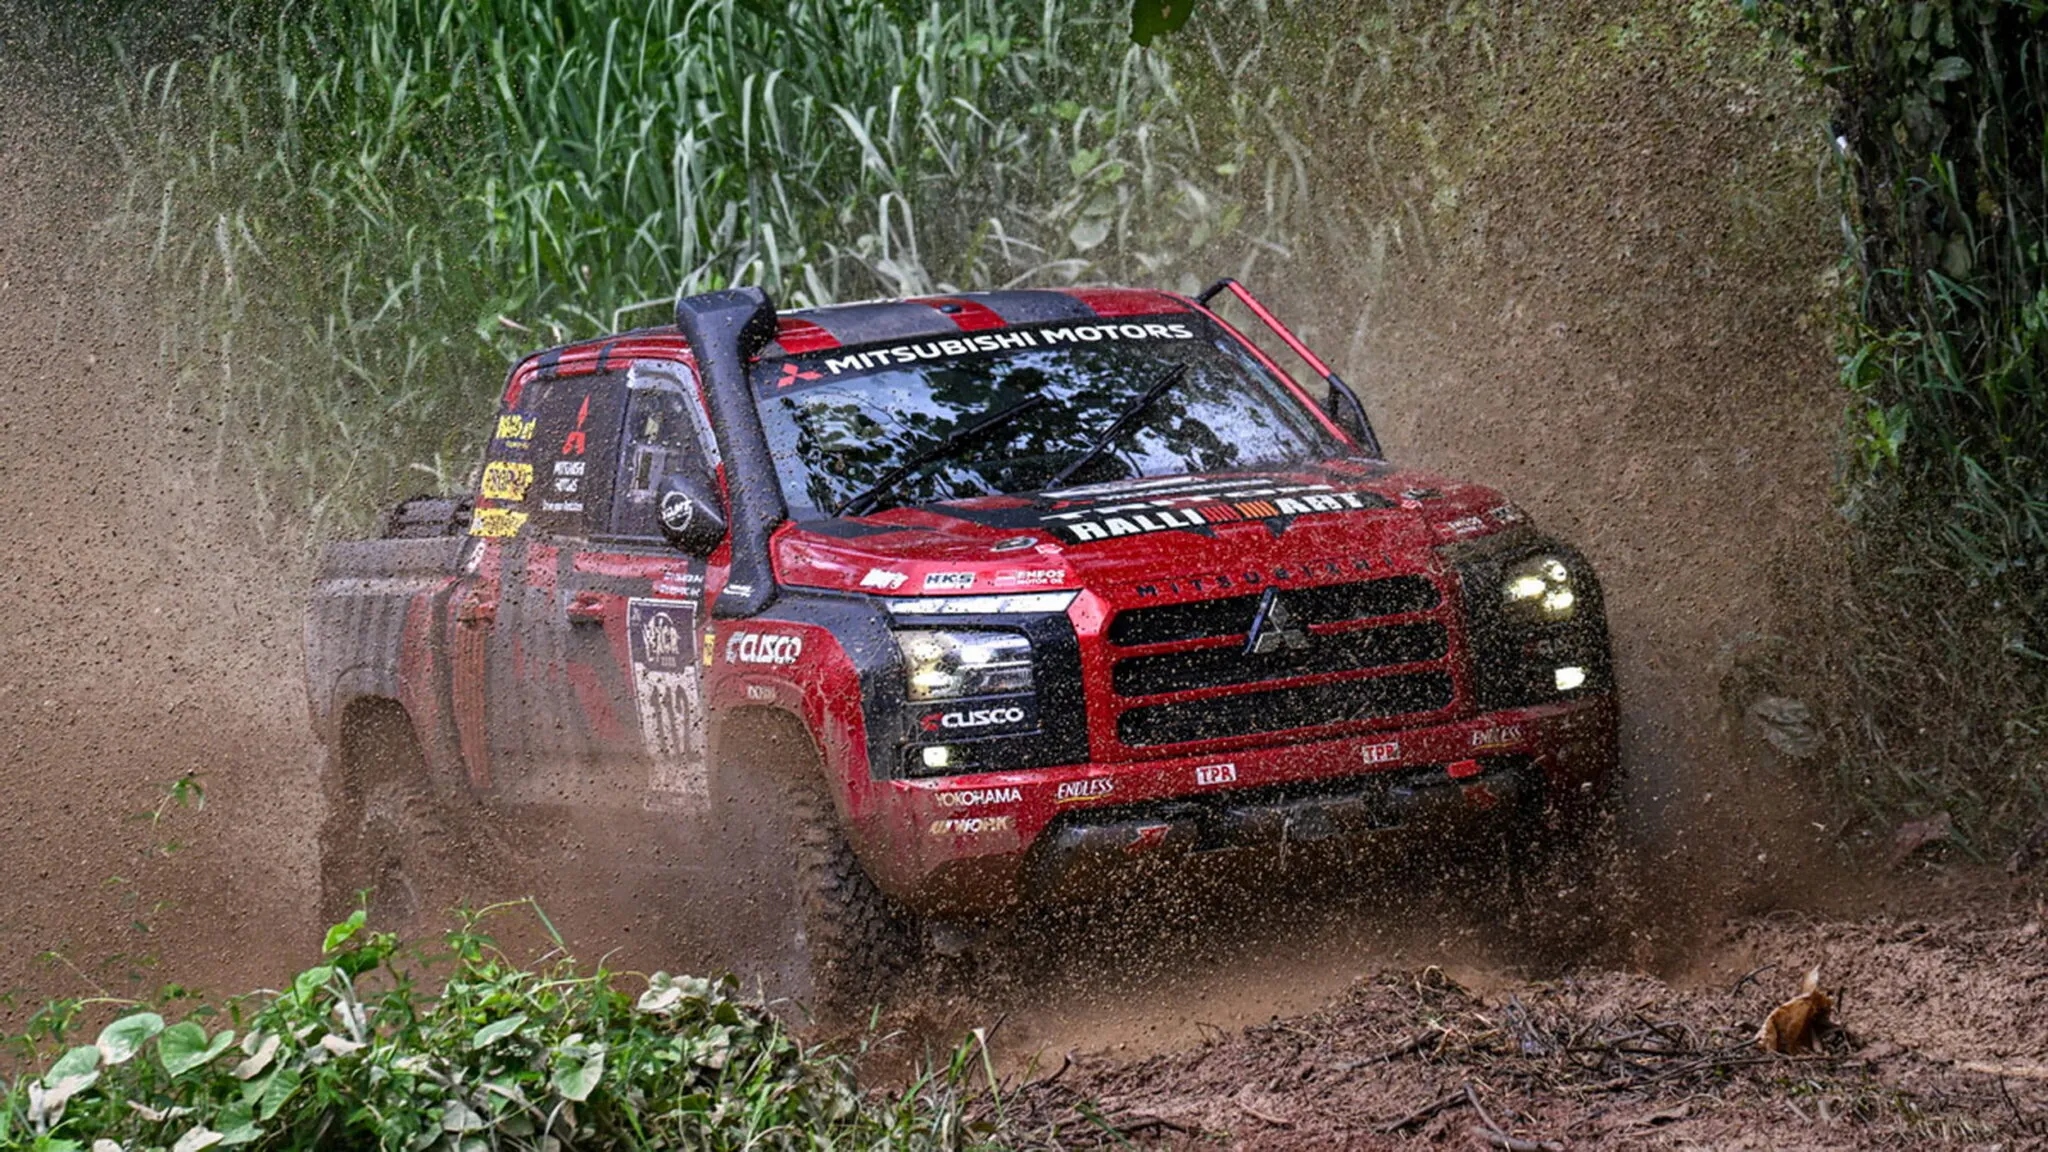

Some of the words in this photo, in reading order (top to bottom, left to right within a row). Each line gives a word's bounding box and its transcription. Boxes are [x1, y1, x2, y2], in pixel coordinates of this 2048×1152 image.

[825, 331, 1037, 375] MITSUBISHI
[1039, 323, 1194, 345] MOTORS
[926, 573, 972, 585] HKS
[1016, 569, 1066, 580] ENEOS
[740, 633, 803, 665] CUSCO
[942, 706, 1025, 729] CUSCO
[1200, 765, 1234, 782] TPR
[935, 787, 1023, 807] YOKOHAMA
[1057, 774, 1115, 800] ENDLESS
